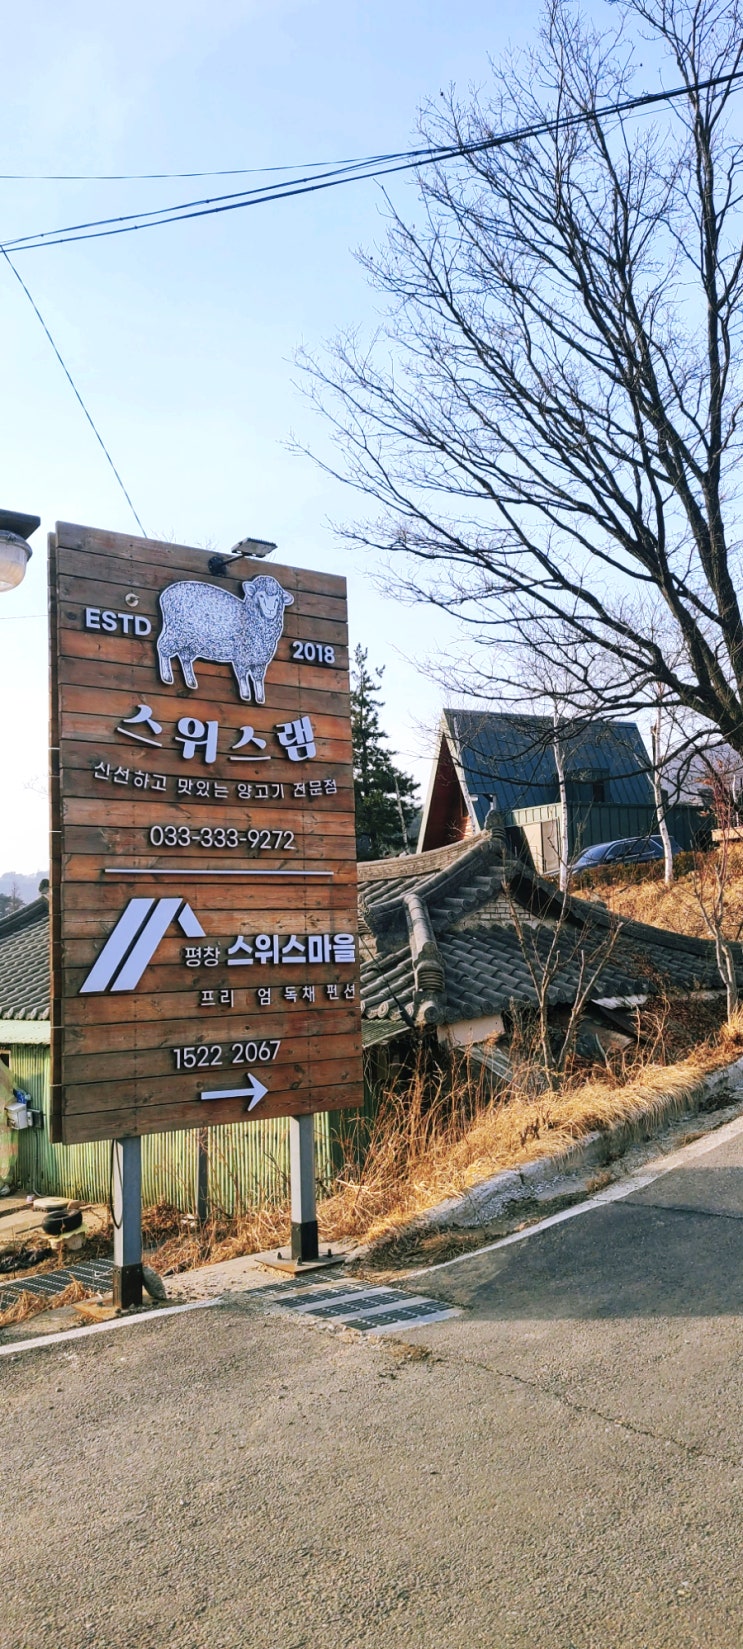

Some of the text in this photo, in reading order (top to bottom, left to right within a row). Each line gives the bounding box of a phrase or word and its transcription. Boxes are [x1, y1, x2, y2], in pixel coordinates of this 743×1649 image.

[85, 607, 335, 664] ESTD 2018
[117, 704, 317, 763] 스위스램
[94, 761, 338, 799] 신선하고 맛있는 양고기 전문점
[150, 826, 295, 850] 033-333-9272
[185, 933, 356, 967] 평창 스위스마을
[284, 985, 316, 1003] 독채
[173, 1040, 281, 1069] 1522 2067
